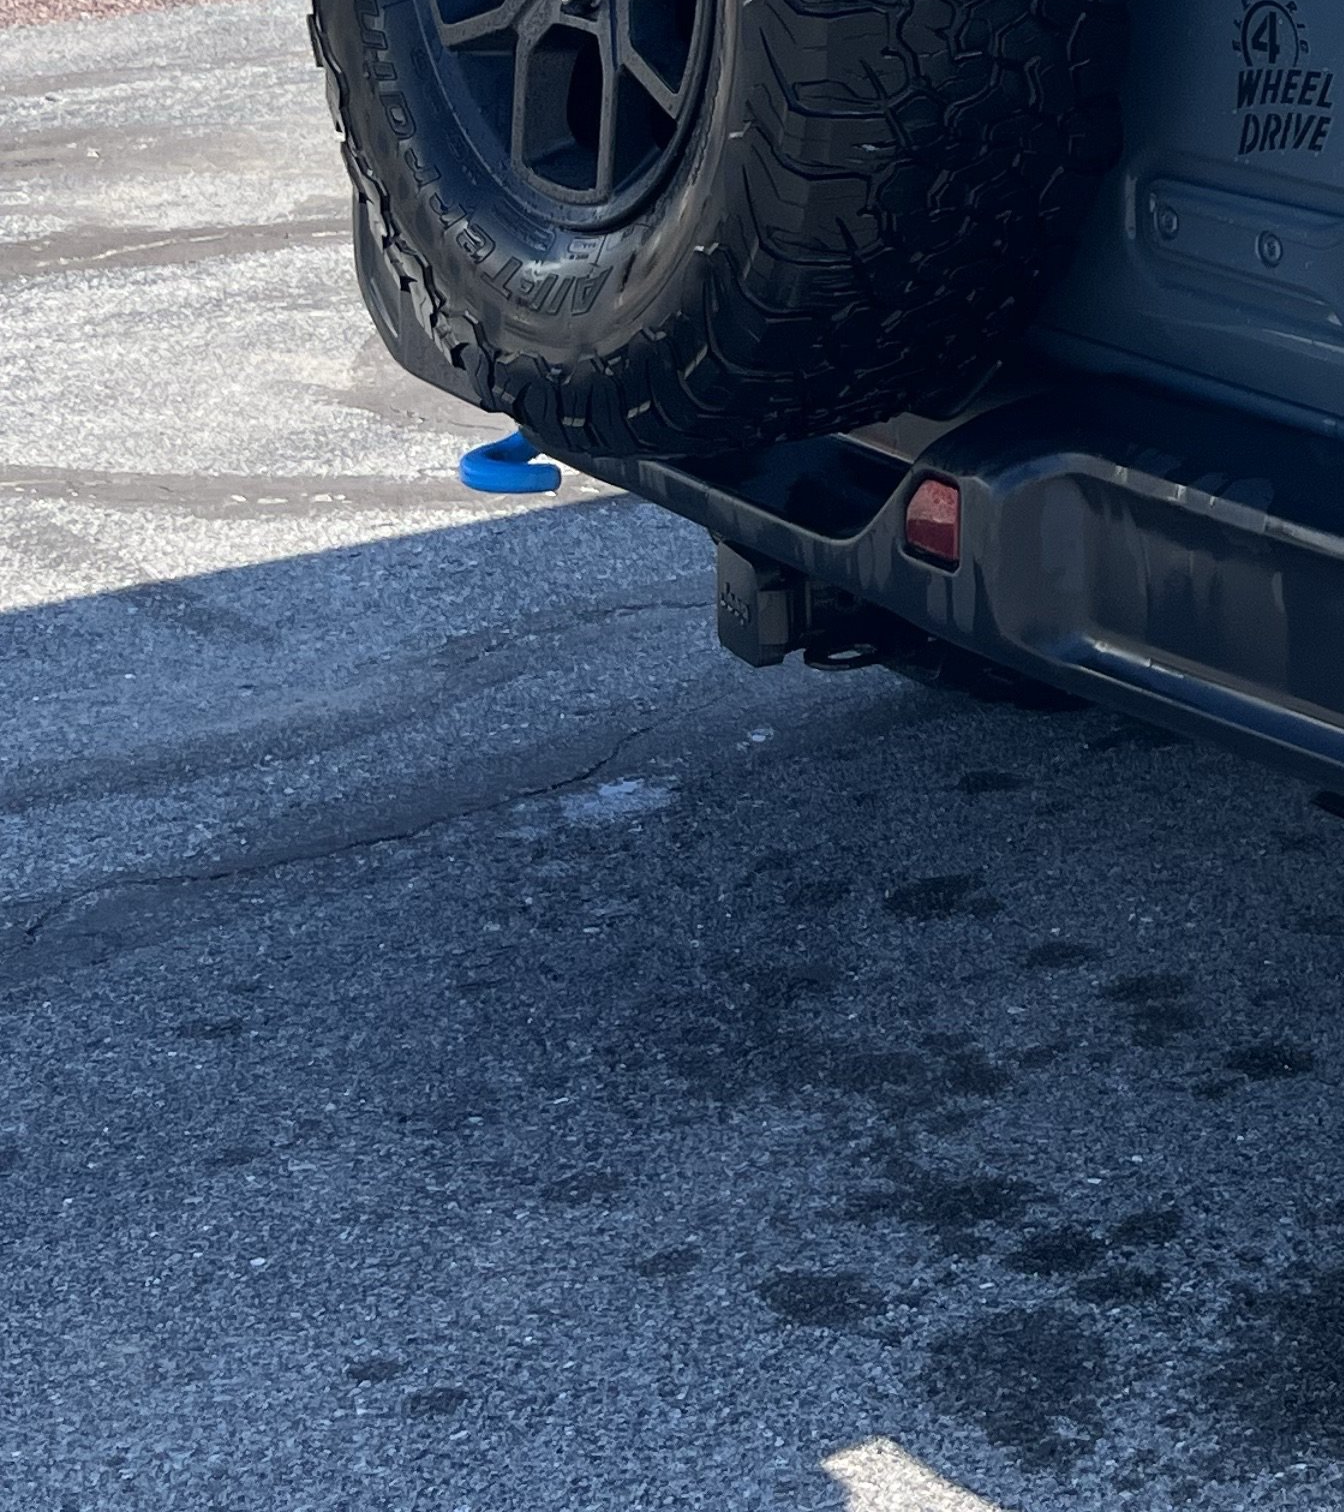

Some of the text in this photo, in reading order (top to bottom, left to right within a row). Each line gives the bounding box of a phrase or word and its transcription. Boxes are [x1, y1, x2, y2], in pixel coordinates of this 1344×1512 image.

[1251, 11, 1280, 64] 4
[1237, 68, 1333, 108] WHEEL
[1238, 112, 1332, 155] DRIVE
